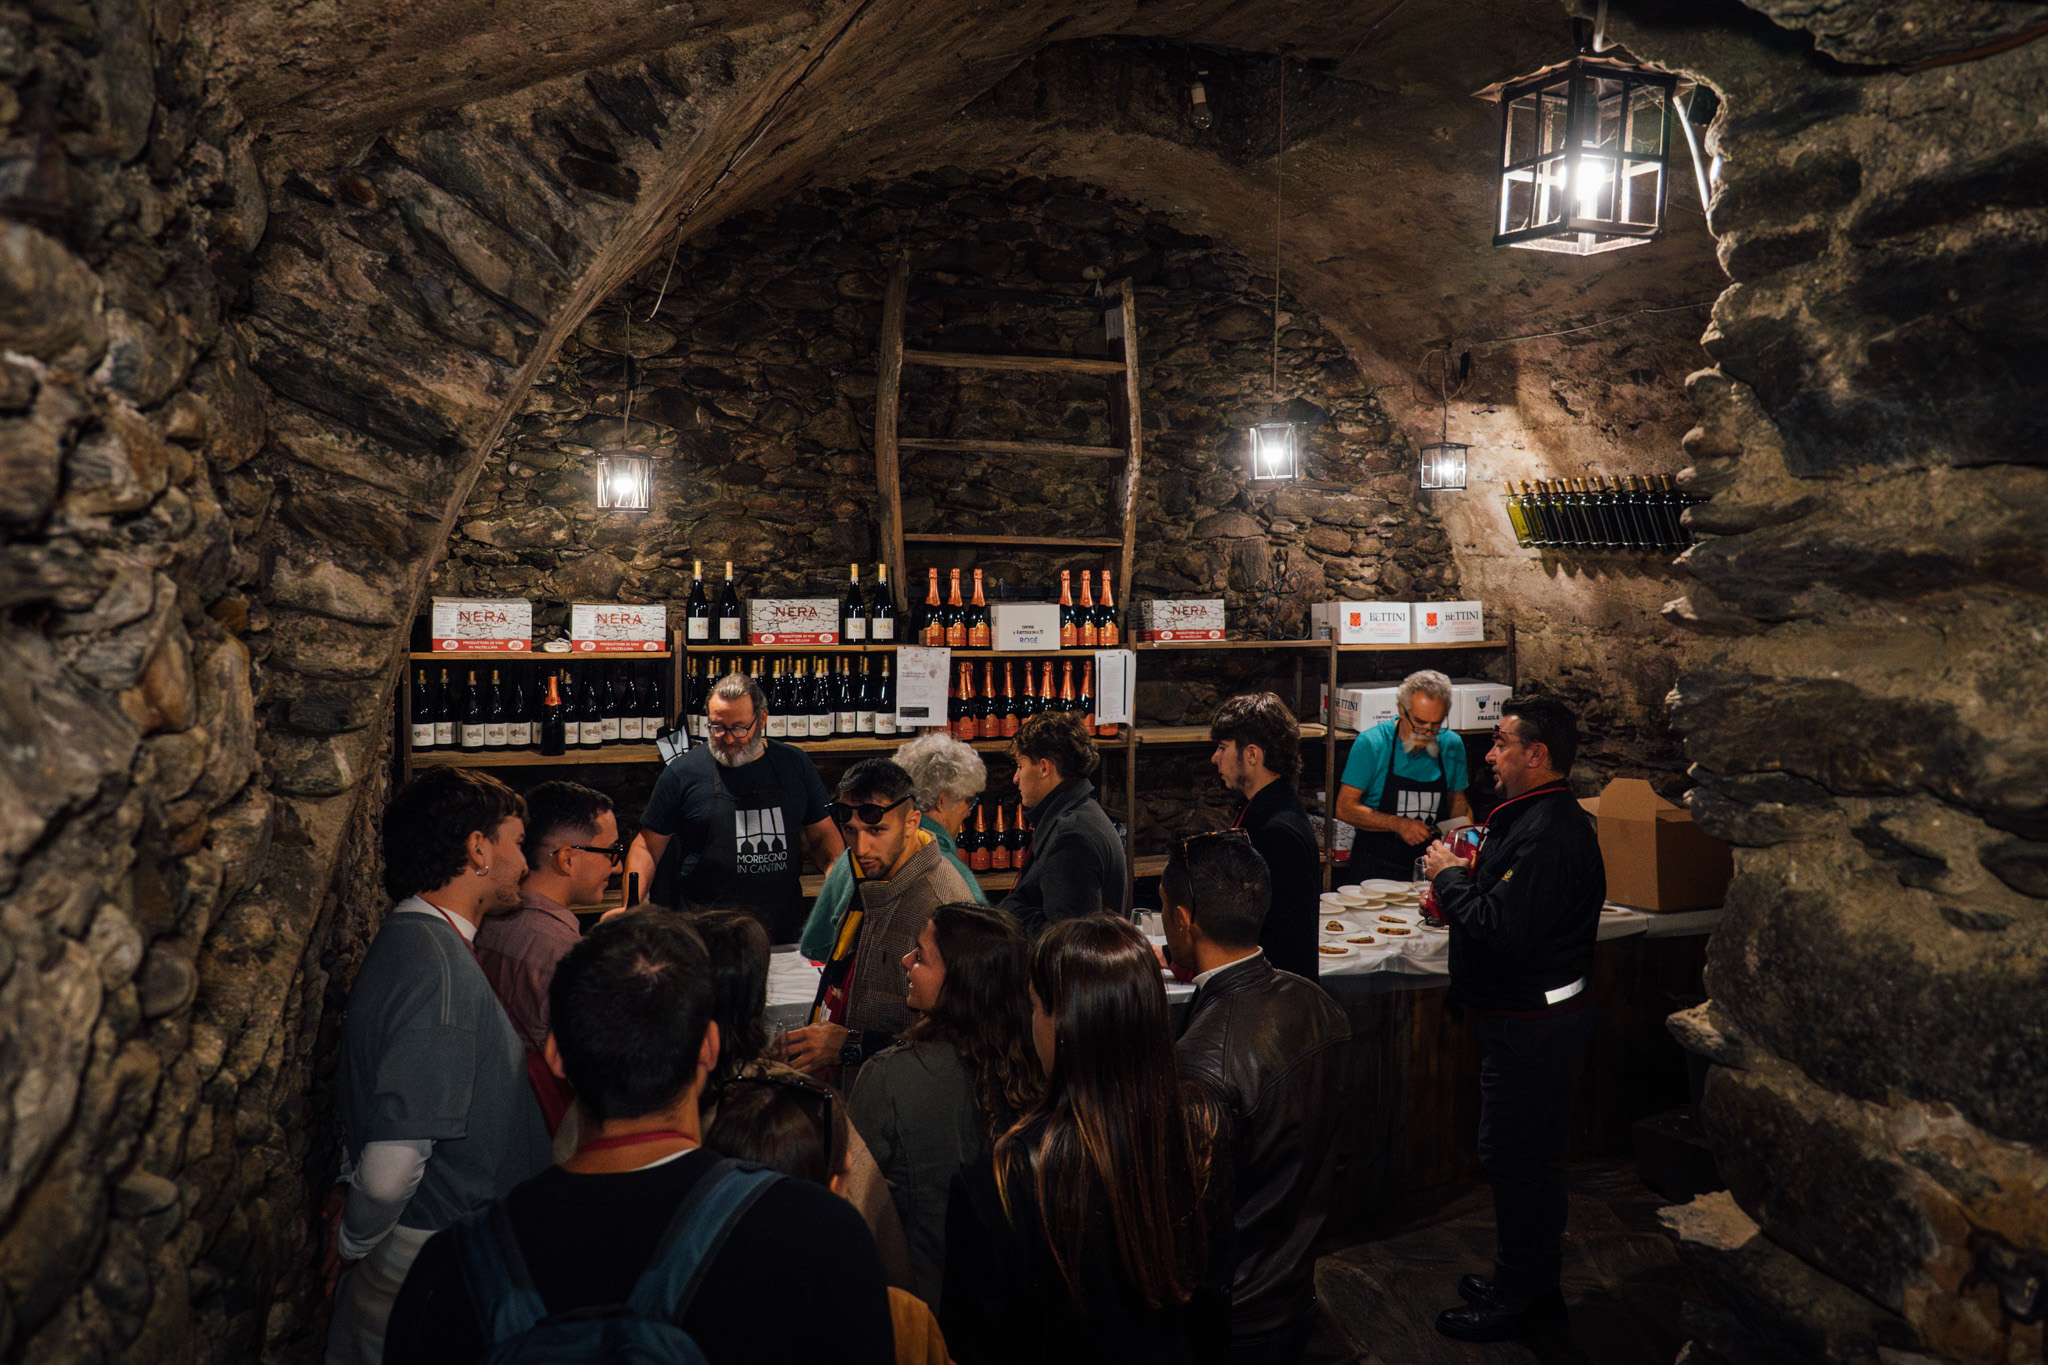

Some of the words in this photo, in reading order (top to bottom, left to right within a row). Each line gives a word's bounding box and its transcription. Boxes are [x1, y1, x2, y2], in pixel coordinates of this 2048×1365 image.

[775, 606, 818, 617] NERA
[1172, 605, 1208, 616] NERA
[1445, 610, 1479, 621] BETTINI
[459, 611, 507, 622] NERA
[596, 613, 642, 624] NERA
[1369, 612, 1406, 622] BETTINI
[737, 851, 788, 864] MORBEGNO
[737, 864, 747, 873] IN
[750, 862, 787, 874] CANTINA
